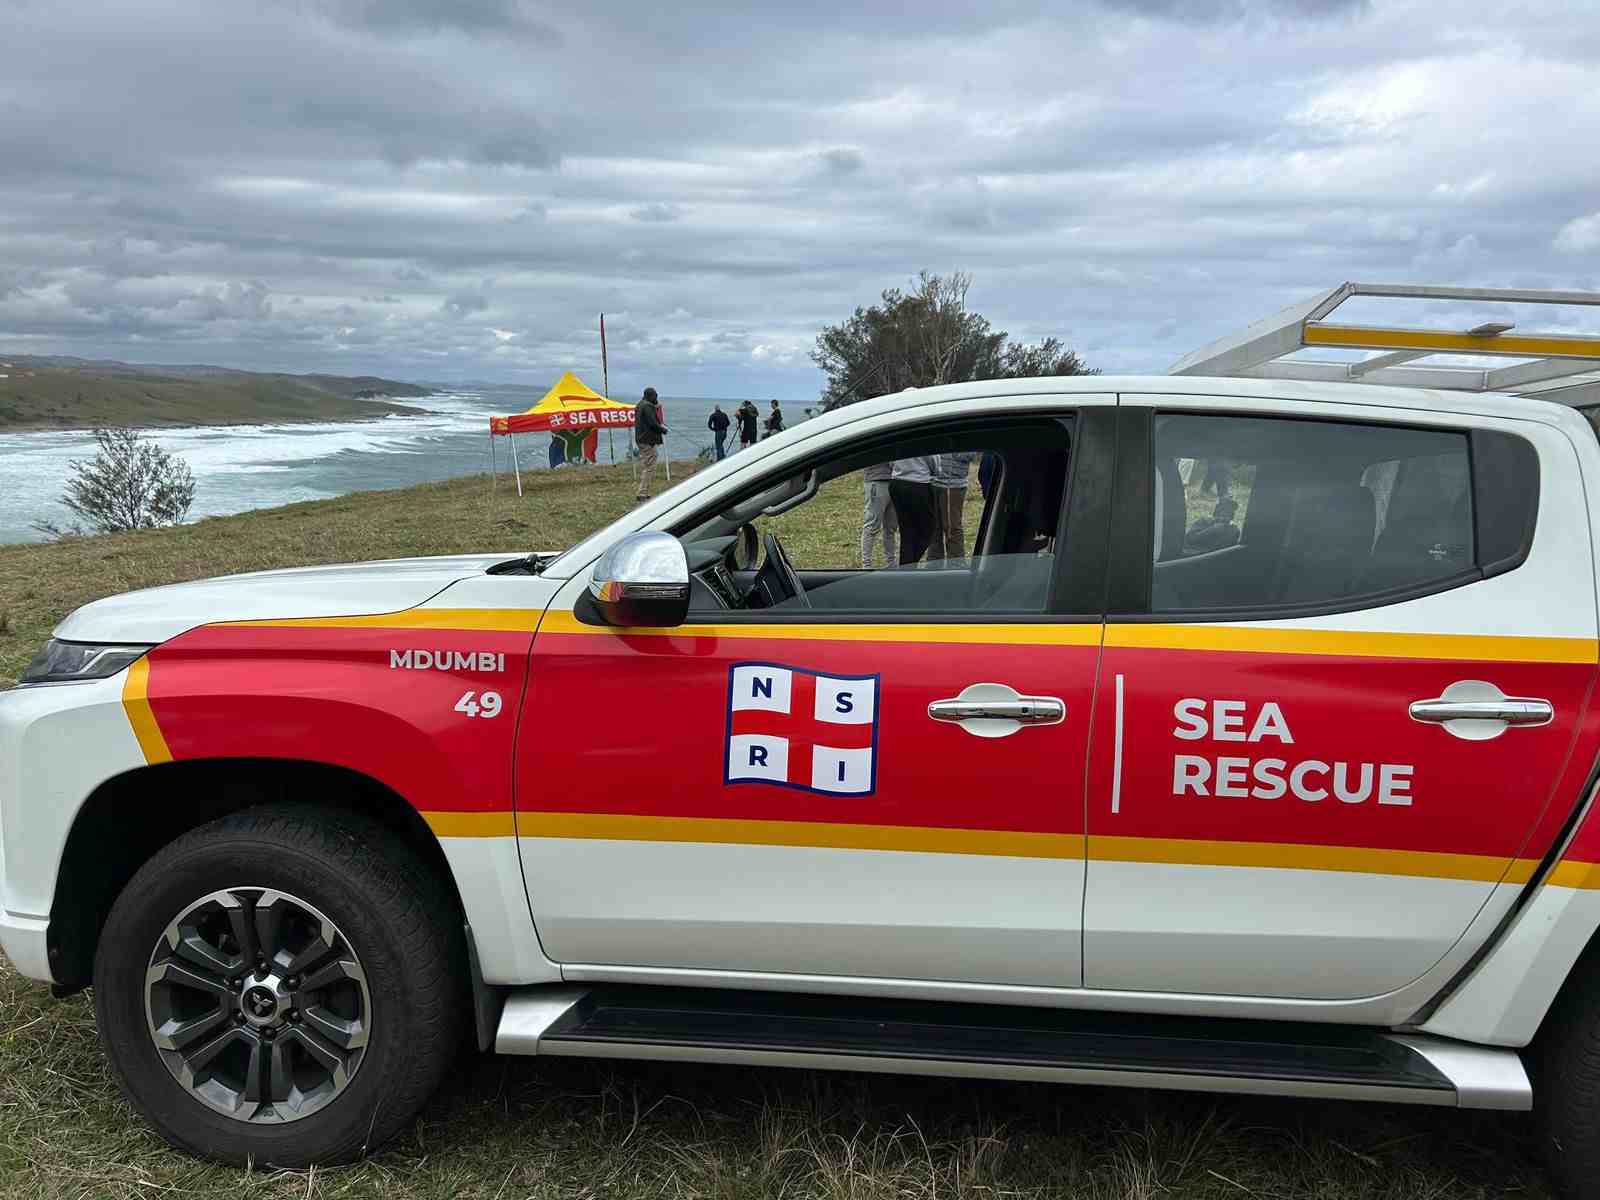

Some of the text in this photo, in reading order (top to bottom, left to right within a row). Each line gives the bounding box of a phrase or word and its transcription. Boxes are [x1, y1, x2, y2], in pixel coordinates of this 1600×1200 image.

[569, 410, 636, 424] SEA RESC
[389, 649, 505, 672] MDUMBI
[454, 691, 502, 718] 49
[751, 677, 854, 714] N S
[1173, 698, 1295, 743] SEA
[749, 745, 846, 782] R I
[1172, 754, 1414, 806] RESCUE
